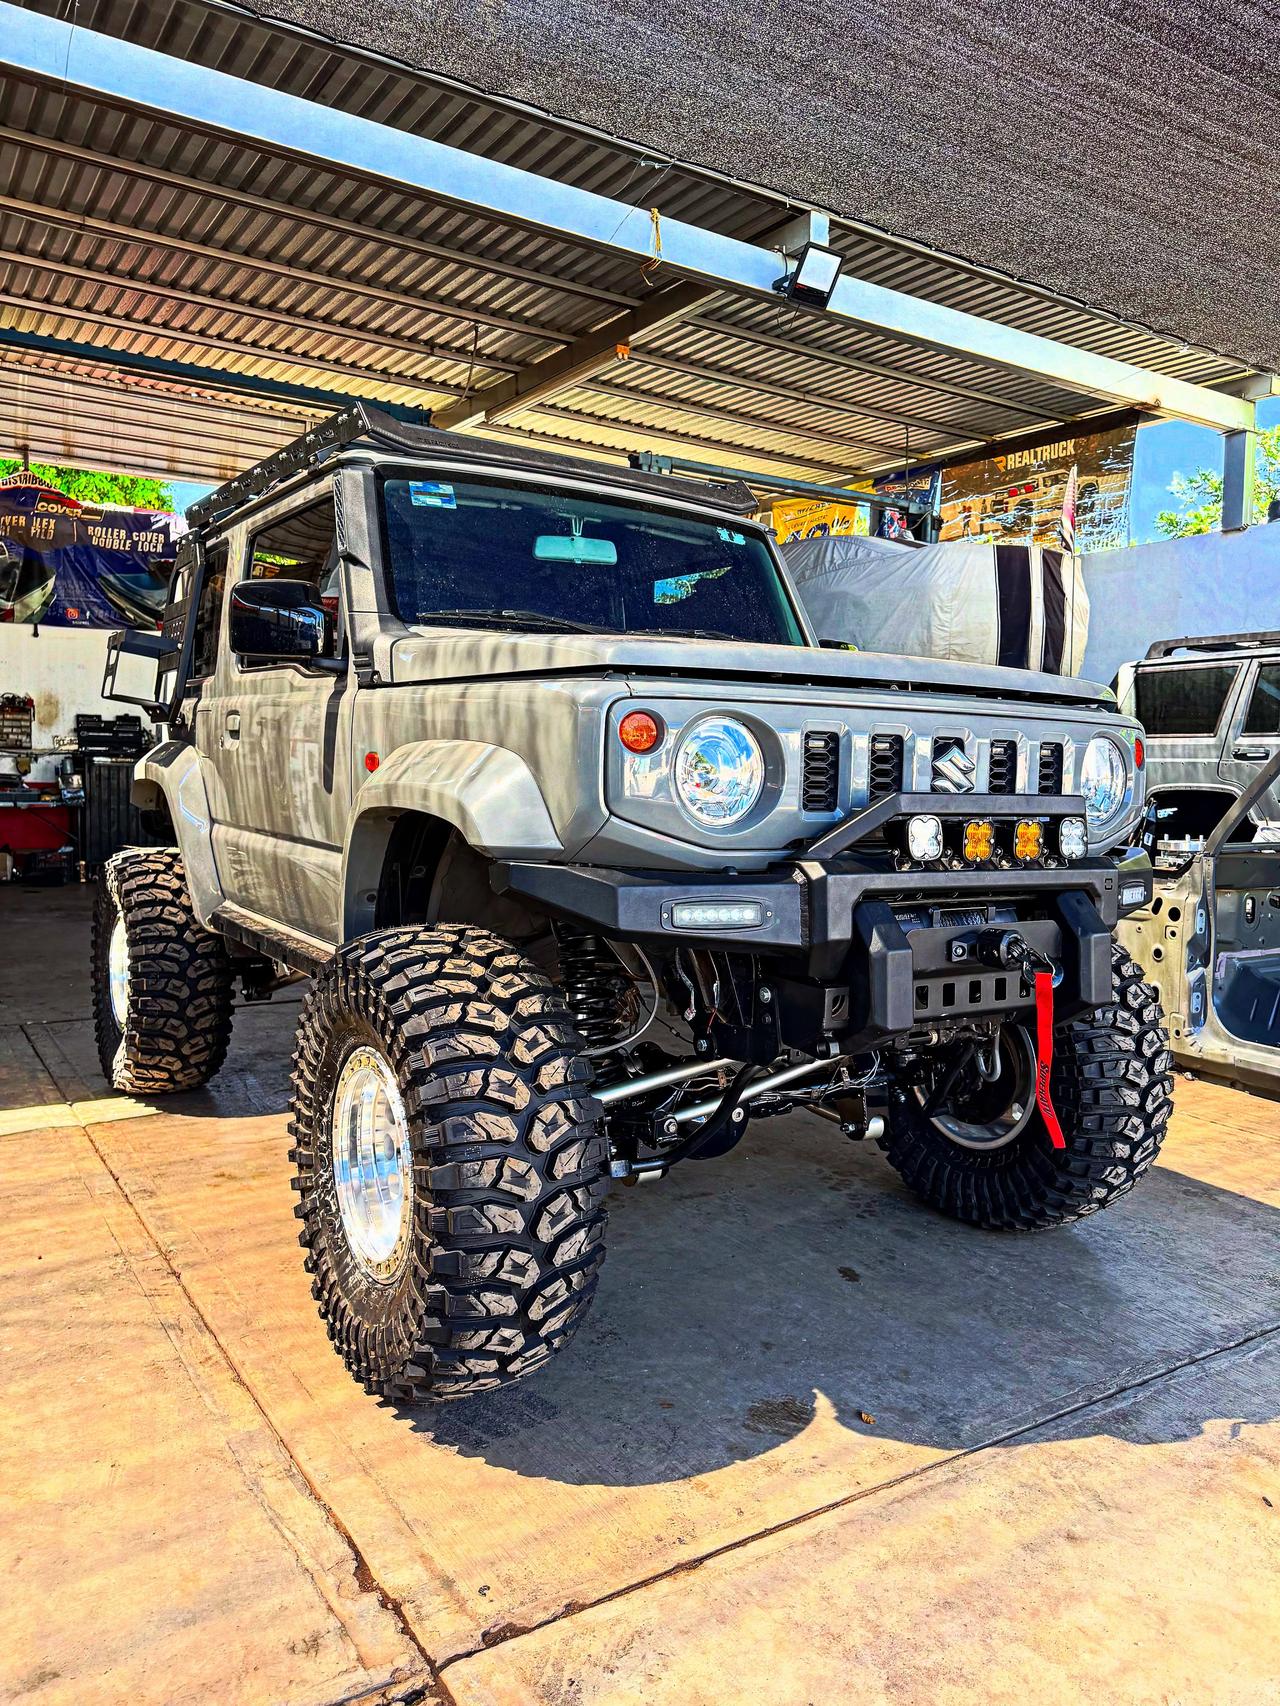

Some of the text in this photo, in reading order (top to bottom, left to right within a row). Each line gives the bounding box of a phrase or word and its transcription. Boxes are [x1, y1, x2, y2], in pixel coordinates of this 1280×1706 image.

[1007, 439, 1076, 470] REALTRUCK
[37, 502, 82, 518] COVER
[87, 525, 165, 544] ROLLER COVER
[92, 535, 163, 553] DOUBLE LOCK
